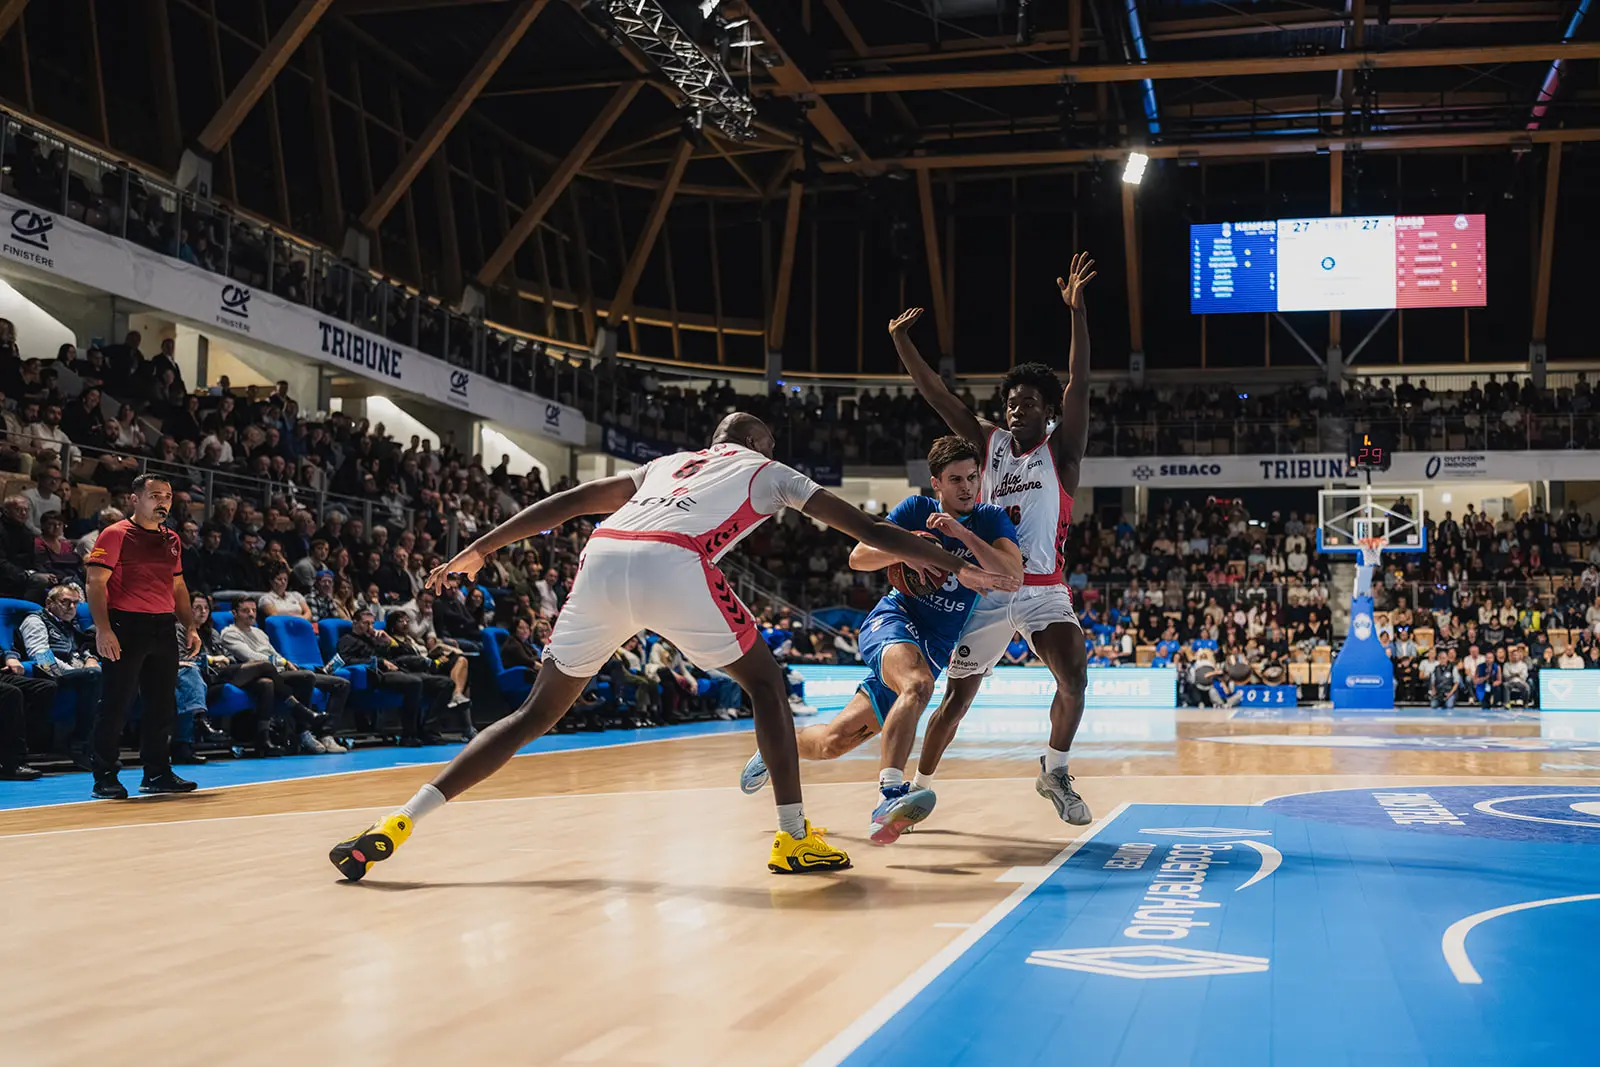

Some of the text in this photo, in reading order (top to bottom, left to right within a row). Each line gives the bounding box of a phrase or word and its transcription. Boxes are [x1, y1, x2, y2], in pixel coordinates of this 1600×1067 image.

[1293, 221, 1310, 233] 27
[1361, 219, 1379, 231] 27
[3, 243, 54, 268] FINISTÈRE
[319, 320, 402, 379] TRIBUNE
[1358, 448, 1382, 465] 29
[1159, 464, 1221, 476] SEBACO
[1001, 472, 1022, 488] Aix
